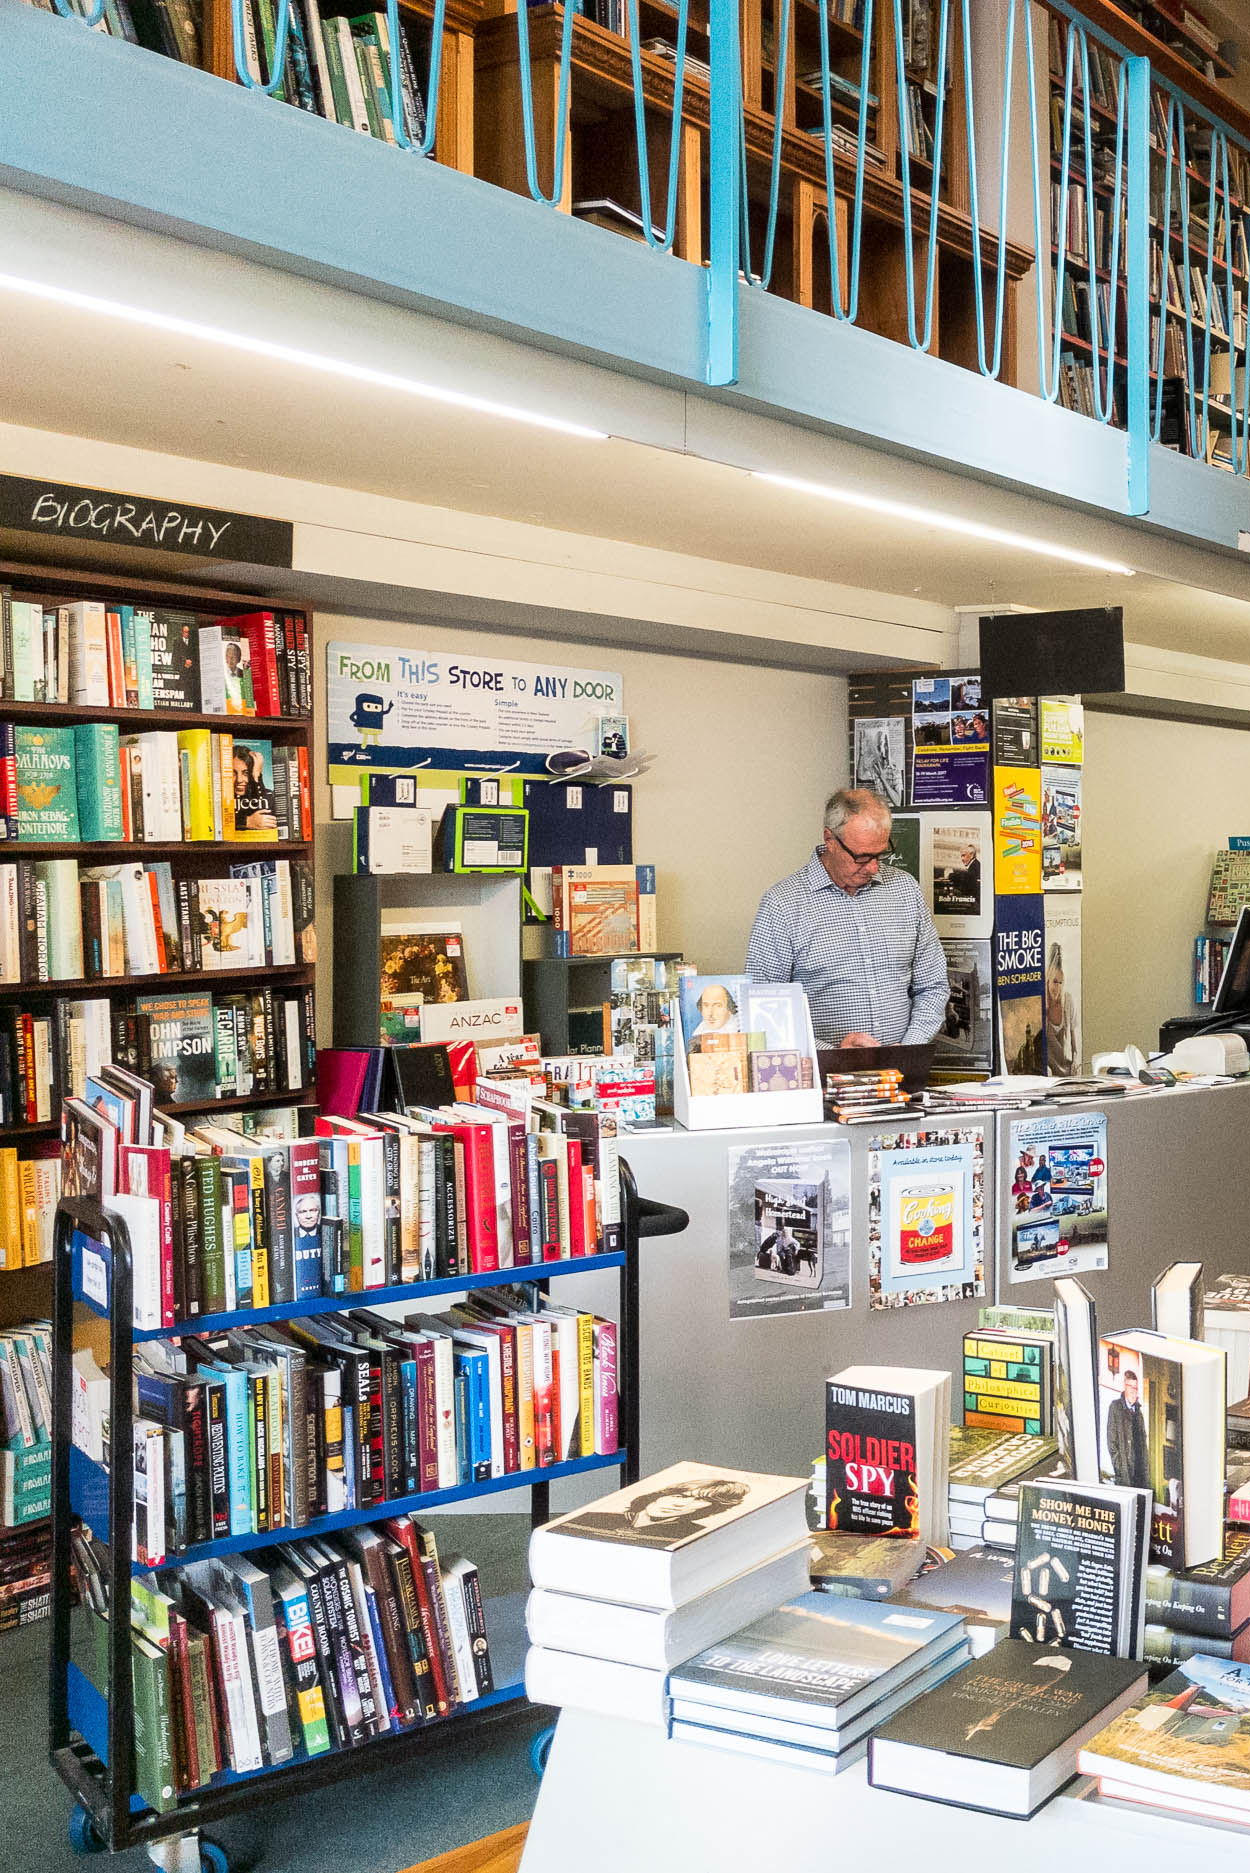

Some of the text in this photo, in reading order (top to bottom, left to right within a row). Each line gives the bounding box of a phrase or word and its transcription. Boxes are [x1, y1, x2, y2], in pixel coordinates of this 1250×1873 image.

[31, 494, 231, 550] BIOGRAPHY
[136, 611, 155, 622] THE
[263, 619, 274, 650] NINJA
[273, 624, 283, 657] MANKELL
[339, 655, 615, 702] FROM THIS STORE TO ANY DOOR
[397, 690, 428, 703] It's easy
[494, 698, 519, 709] Simple
[290, 760, 300, 798] RADICAL
[575, 869, 594, 880] 1000
[180, 882, 190, 925] LAST STAND
[938, 895, 976, 904] Bob Francis
[36, 882, 49, 982] GRAHAM NORTON
[998, 929, 1042, 950] THE BIG
[998, 950, 1042, 971] SMOKE
[997, 971, 1042, 986] BEN SCHRADER
[117, 1021, 126, 1046] SULLY
[236, 1011, 246, 1051] EMMA SKY
[450, 1012, 502, 1029] ANZAC
[253, 1015, 265, 1060] WOLF BOYS
[294, 1158, 319, 1168] ROBERT
[185, 1179, 198, 1220] Gunther
[528, 1141, 540, 1235] Ahdaf Soueif Cairo
[584, 1173, 595, 1201] pasta
[203, 1168, 217, 1251] TED HUGHES
[765, 1207, 806, 1220] Homestead
[904, 1199, 952, 1225] Cooking
[295, 1250, 322, 1261] DUTY
[908, 1233, 945, 1248] CHANGE
[583, 1319, 592, 1344] RESCUE
[584, 1352, 592, 1366] LOS
[601, 1332, 617, 1398] Black Venus
[981, 1346, 1020, 1360] Cabinet
[503, 1343, 515, 1414] KREMLIN CONSPIRACY
[995, 1365, 1005, 1377] of
[831, 1387, 911, 1415] TOM MARCUS
[967, 1380, 1039, 1399] Philosophical
[979, 1399, 1040, 1416] Curiosities
[255, 1378, 266, 1469] GOLF MY WAY JACK NICKLAUS
[408, 1388, 418, 1467] DRAWING MAP LIFE
[236, 1412, 246, 1481] HOW TO BAKE
[390, 1401, 400, 1480] ORPHEUS CLOCK
[828, 1429, 915, 1473] SOLDIER
[950, 1434, 1033, 1478] CALENDAR
[211, 1424, 225, 1494] REINVENTING POLITICS
[974, 1439, 1045, 1478] COUNTRY
[845, 1463, 896, 1497] SPY
[1031, 1509, 1117, 1535] MONEY, HONEY
[1040, 1498, 1116, 1522] SHOW ME THE
[1162, 1543, 1173, 1557] On
[321, 1577, 338, 1629] SOLAR SYSTEM
[338, 1567, 360, 1642] THE COSMIC TOURIST
[388, 1597, 401, 1631] DRIVING
[289, 1602, 313, 1659] BIKE!
[310, 1583, 331, 1656] COUNTRY ROOMS
[705, 1655, 861, 1690] TO THE LANDSCAPE
[758, 1651, 870, 1679] LOVE LETTERS
[1219, 1674, 1241, 1685] FOR
